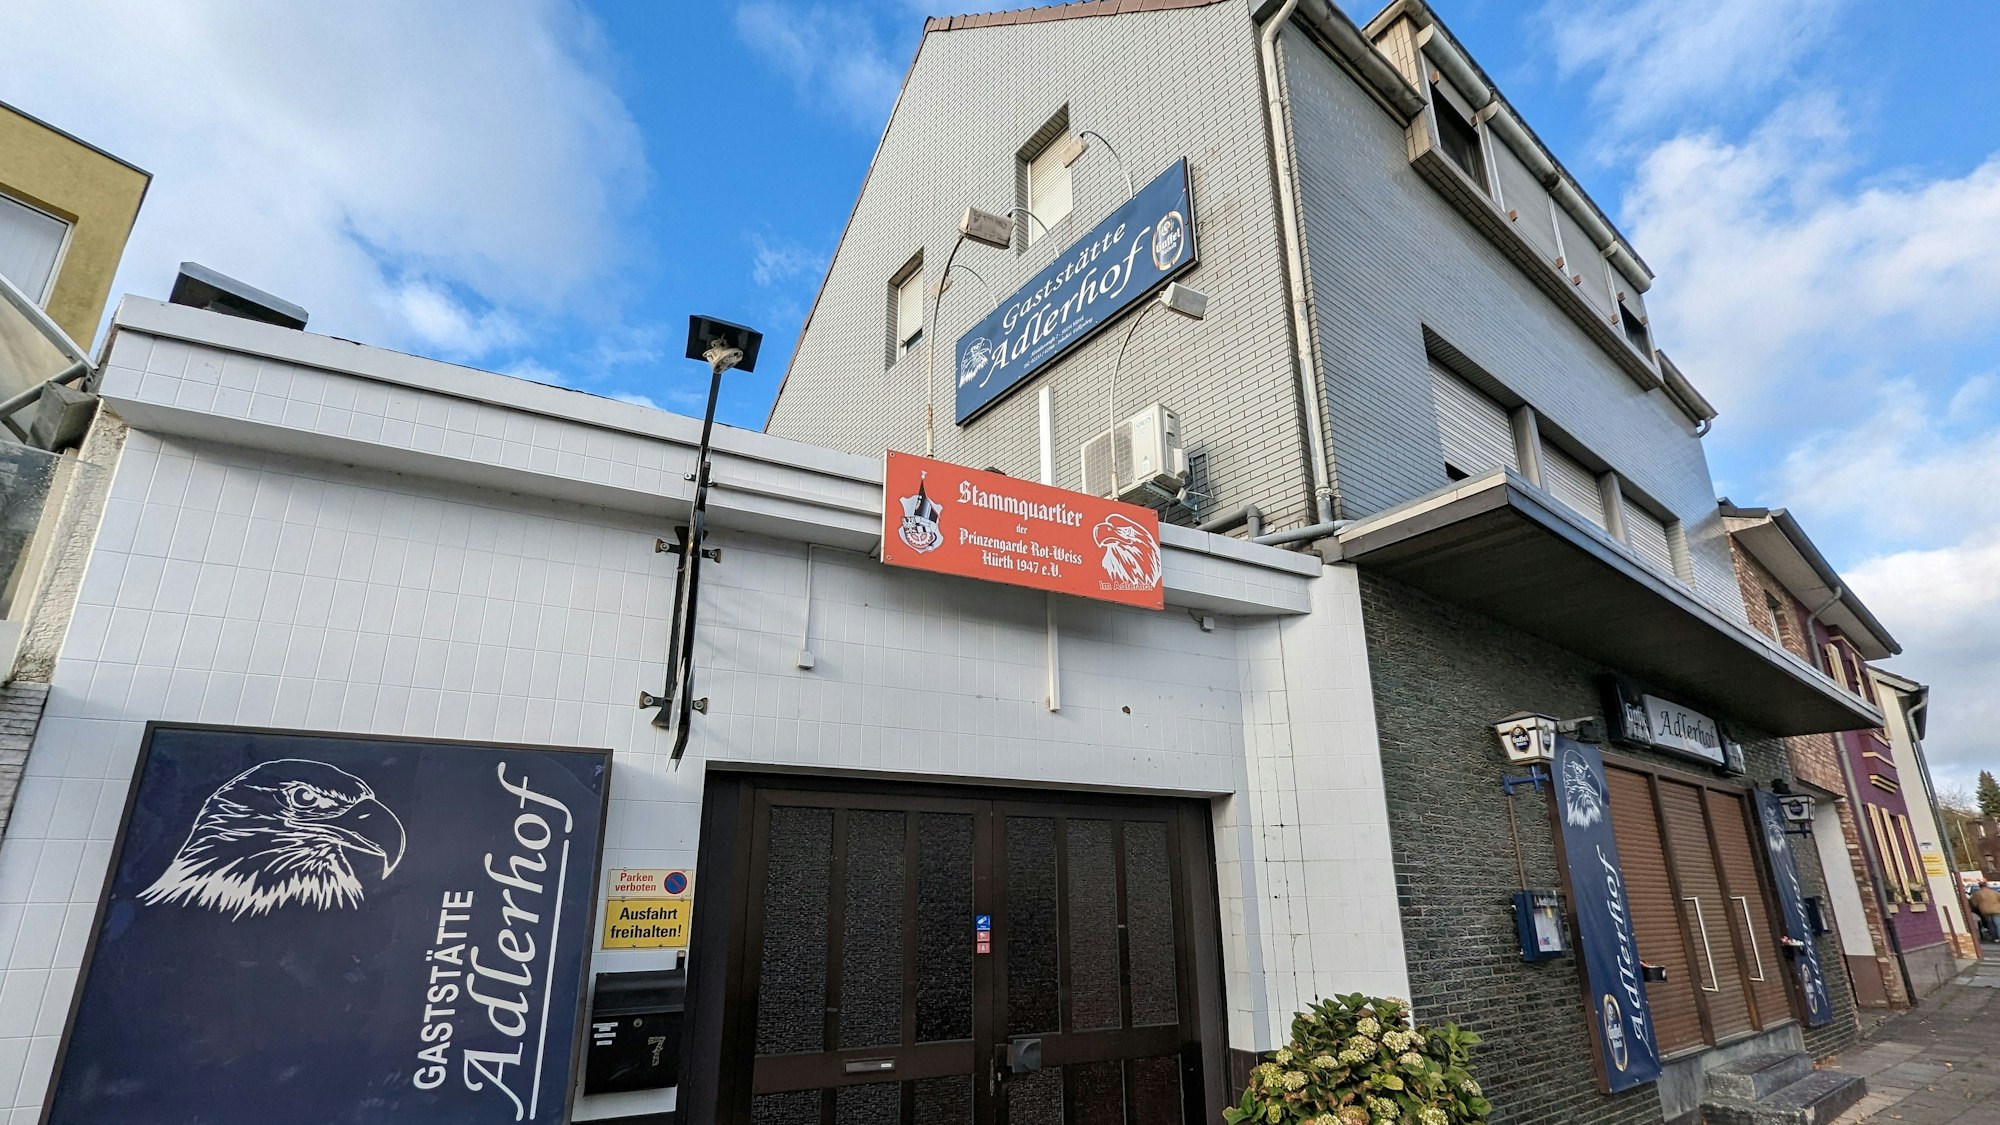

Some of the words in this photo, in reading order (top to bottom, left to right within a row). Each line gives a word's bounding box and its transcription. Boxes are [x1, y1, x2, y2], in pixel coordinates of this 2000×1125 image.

[1002, 222, 1126, 336] Gaststätte
[979, 226, 1151, 388] Adlerhof
[957, 480, 1083, 527] Stammquartier
[959, 527, 1028, 555] Prinzengarde
[1031, 541, 1083, 565] Rot-Weiss
[1016, 524, 1029, 534] der
[982, 549, 1014, 570] Hürth
[1016, 558, 1039, 574] 1947
[1042, 562, 1062, 578] e.V.
[1659, 711, 1715, 749] Adlerhof
[615, 882, 657, 892] verboten
[620, 872, 654, 882] Parken
[610, 924, 682, 939] freihalten!
[619, 907, 678, 921] Ausfahrt
[463, 761, 573, 1121] Adlerhof
[1597, 845, 1653, 1058] Adlerhof
[413, 890, 474, 1090] GASTSTÄTTE
[647, 1036, 666, 1067] 7
